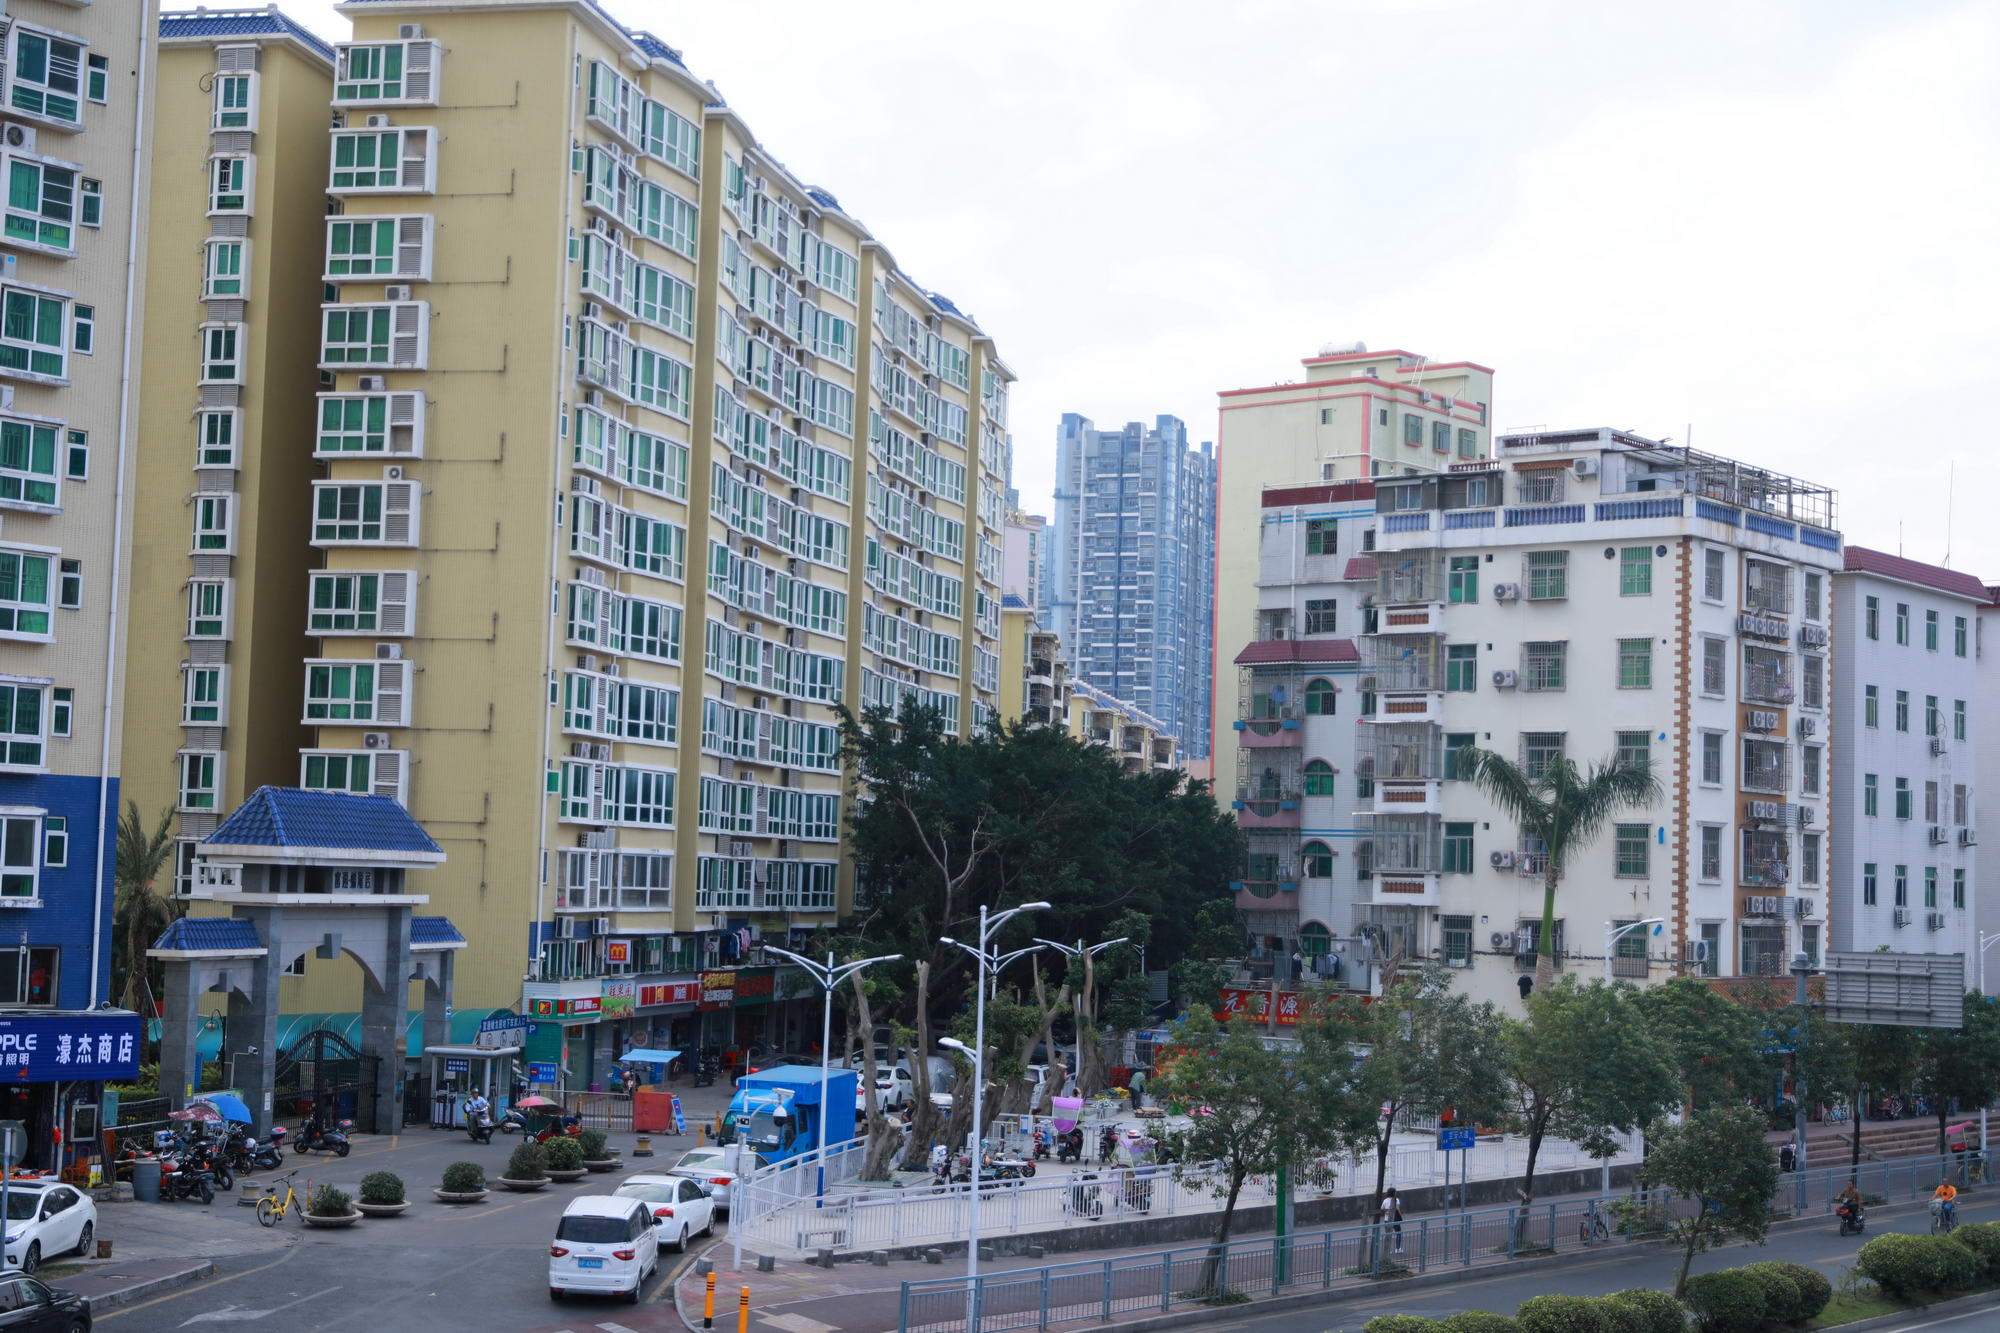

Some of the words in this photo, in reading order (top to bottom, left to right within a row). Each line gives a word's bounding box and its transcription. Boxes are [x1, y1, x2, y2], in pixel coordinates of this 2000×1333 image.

[529, 1024, 536, 1034] P
[0, 1033, 38, 1051] PLE
[56, 1033, 133, 1064] 濠杰商店
[0, 1052, 30, 1066] 照明
